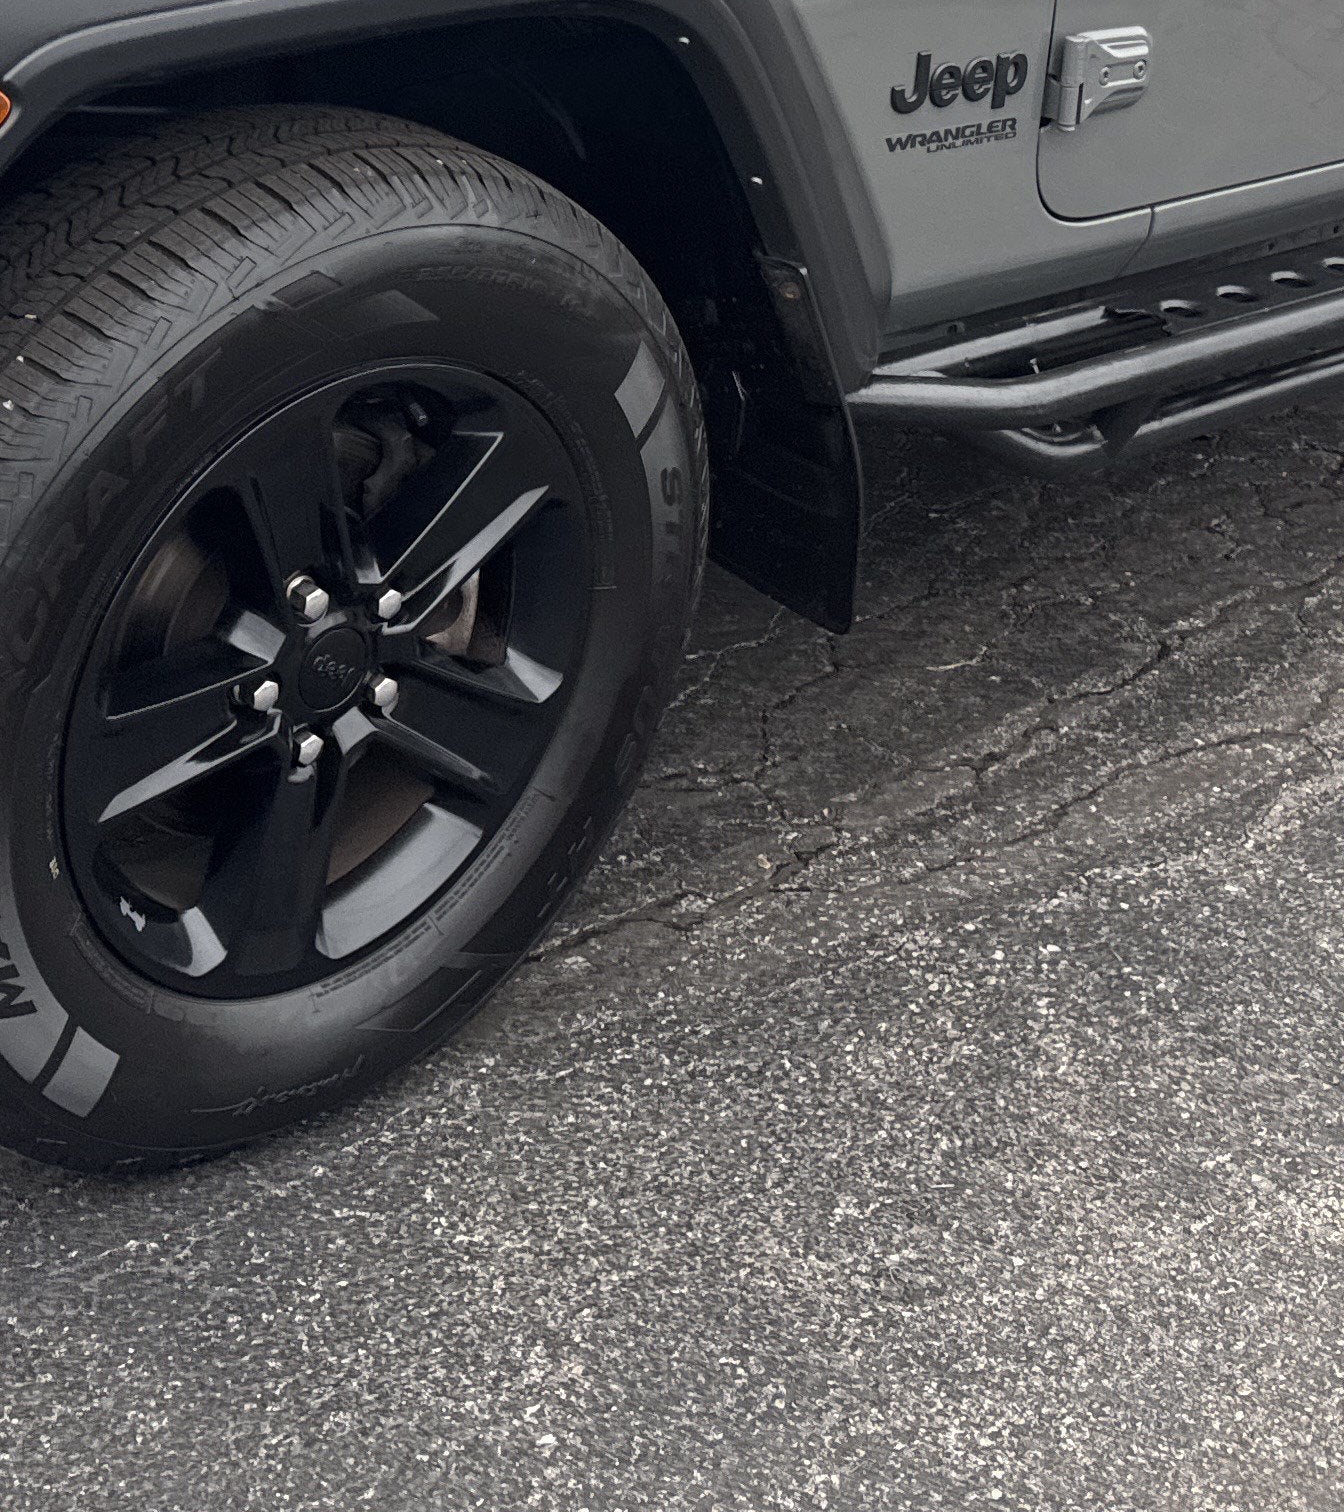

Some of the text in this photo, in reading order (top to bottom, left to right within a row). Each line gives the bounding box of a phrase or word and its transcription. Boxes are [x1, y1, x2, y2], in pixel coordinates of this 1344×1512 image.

[890, 50, 1028, 114] Jeep
[886, 117, 1017, 152] WRANGLER
[926, 131, 1017, 153] UNLIMITED
